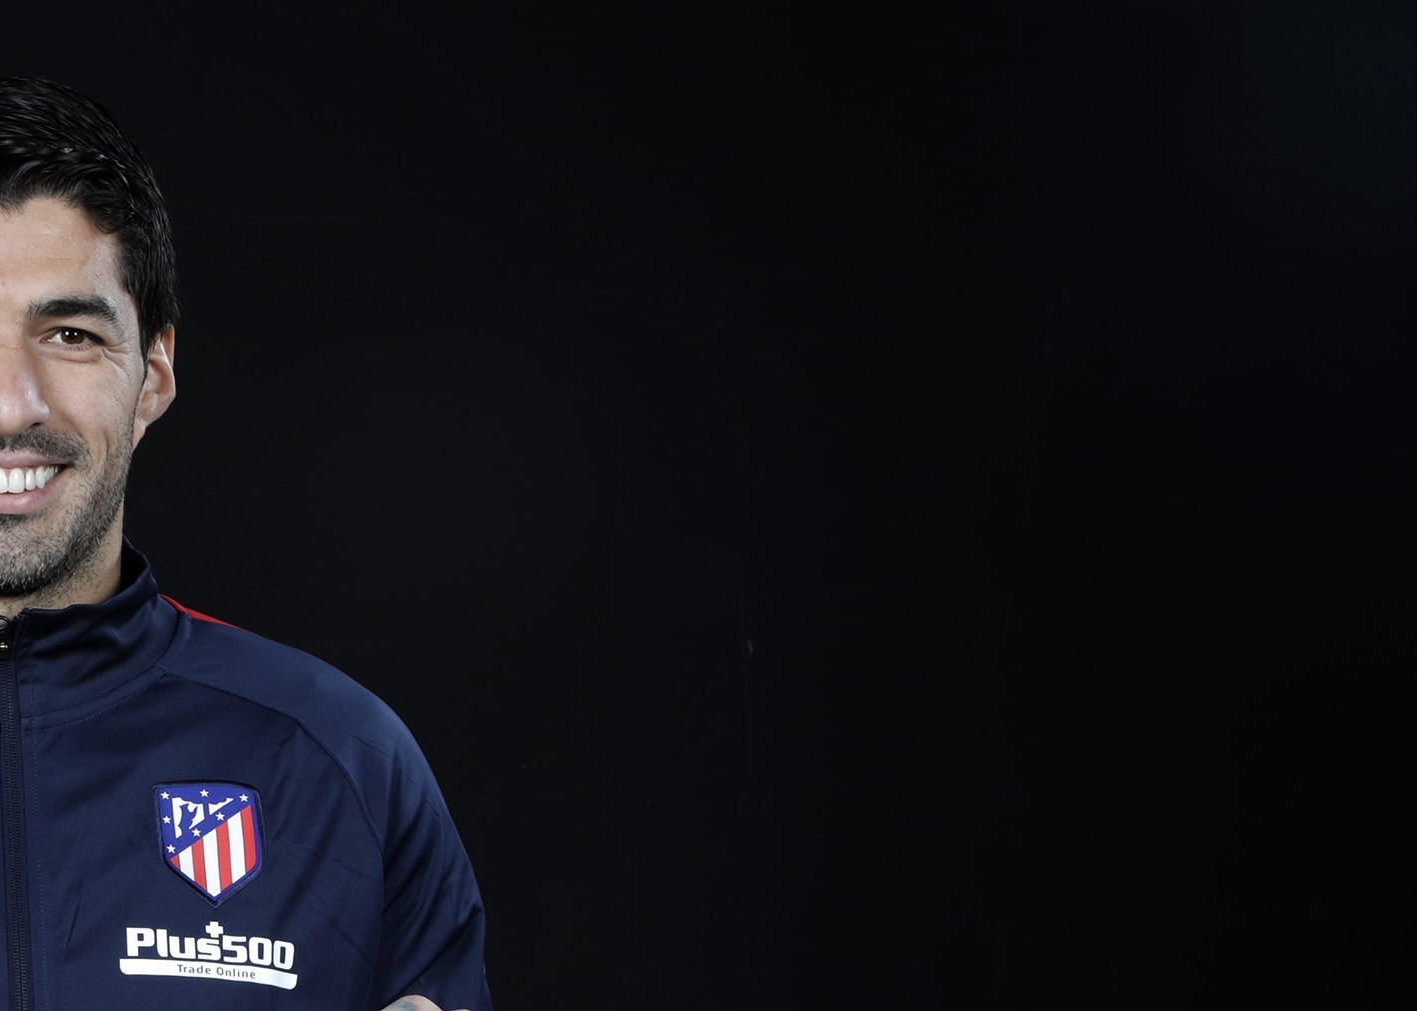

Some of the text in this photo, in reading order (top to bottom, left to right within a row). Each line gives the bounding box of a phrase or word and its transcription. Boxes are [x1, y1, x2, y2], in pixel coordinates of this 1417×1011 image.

[126, 921, 295, 971] Plus500
[177, 964, 256, 979] Trade Online
